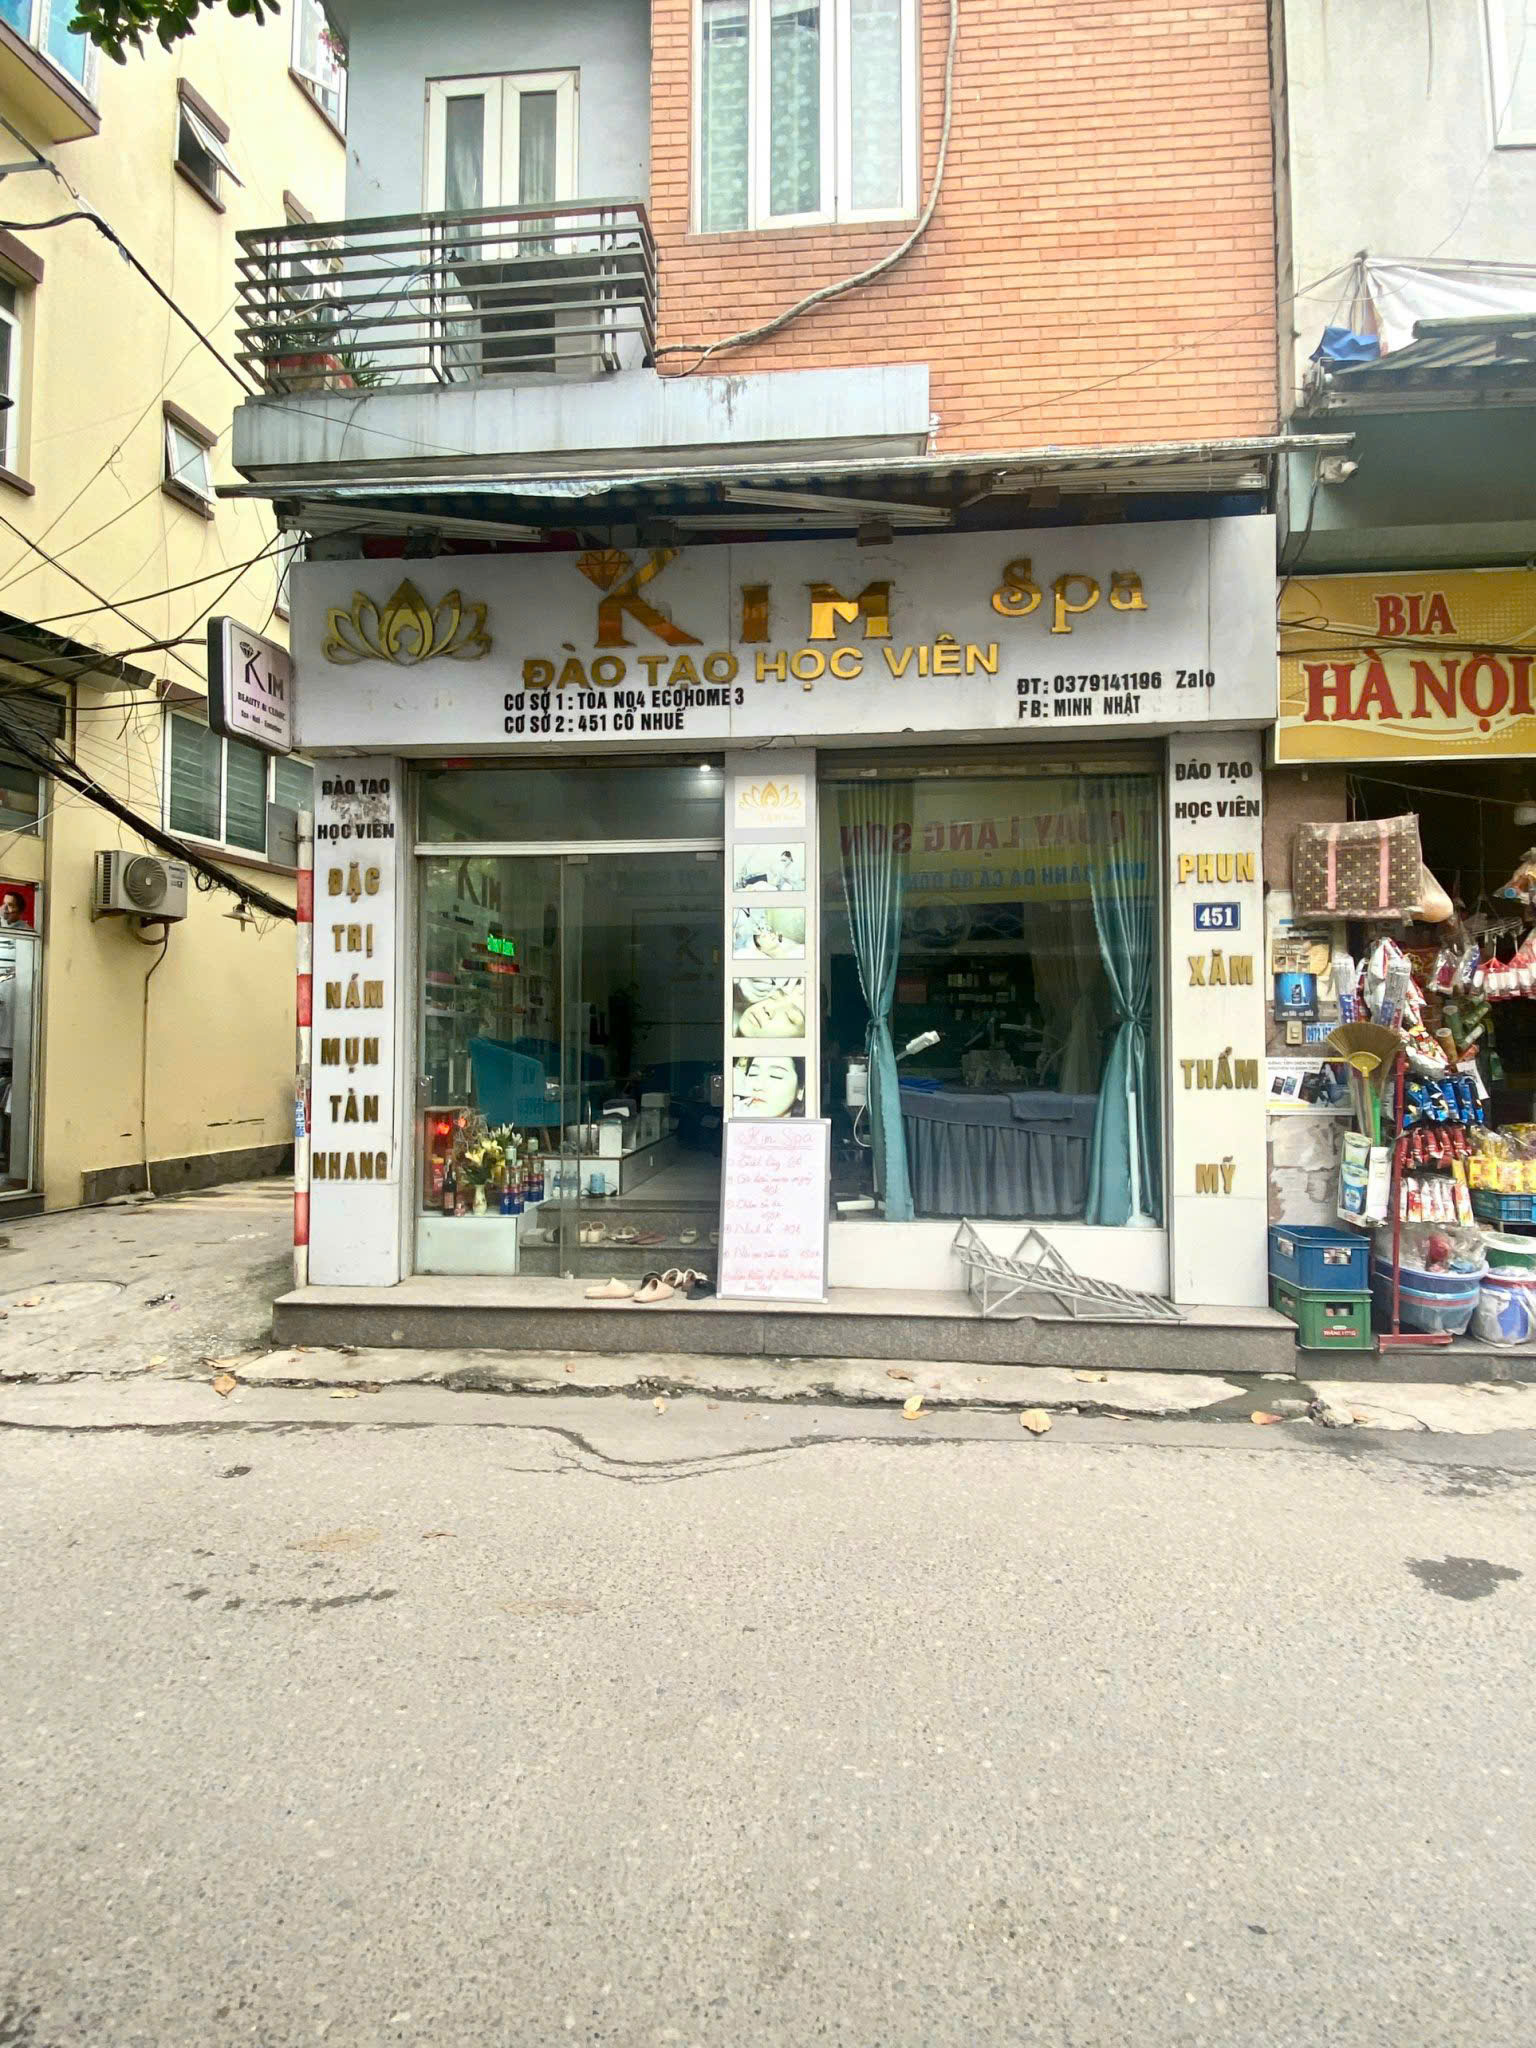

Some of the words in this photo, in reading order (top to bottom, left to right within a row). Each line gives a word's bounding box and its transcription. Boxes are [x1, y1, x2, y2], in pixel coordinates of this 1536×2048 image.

[590, 548, 895, 648] KIM
[991, 558, 1148, 634] Spa
[1375, 593, 1457, 636] BIA
[244, 649, 284, 701] KIM
[522, 642, 627, 690] ĐÀO
[637, 651, 738, 692] TẠO
[755, 647, 864, 692] HỌC
[883, 632, 999, 679] VIÊN
[504, 692, 525, 711] CƠ
[530, 686, 551, 711] SỞ
[577, 687, 607, 709] TÒA
[652, 688, 730, 708] ECOHOME
[734, 688, 744, 705] 3
[1054, 671, 1162, 694] 0379141196
[1176, 669, 1215, 689] Zalo
[1302, 648, 1403, 722] HÀ
[1410, 651, 1536, 733] NỘI
[504, 714, 525, 734] CƠ
[530, 710, 551, 733] SỞ
[578, 714, 606, 732] 451
[613, 707, 637, 731] CỔ
[1054, 697, 1092, 717] MINH
[1103, 693, 1141, 717] NHẬT
[360, 778, 390, 801] TẠO
[1217, 761, 1253, 784] TẠO
[1175, 801, 1212, 824] HỌC
[1217, 795, 1260, 817] VIÊN
[317, 823, 352, 846] HỌC
[328, 862, 380, 903] ĐẶC
[1178, 853, 1255, 884] PHUN
[1199, 907, 1233, 927] 451
[332, 924, 374, 959] TRỊ
[1188, 948, 1254, 986] XĂM
[325, 973, 384, 1010] NÁM
[321, 1037, 379, 1074] MỤN
[329, 1087, 379, 1123] TÀN
[313, 1151, 388, 1181] NHANG
[1195, 1155, 1237, 1194] MỸ
